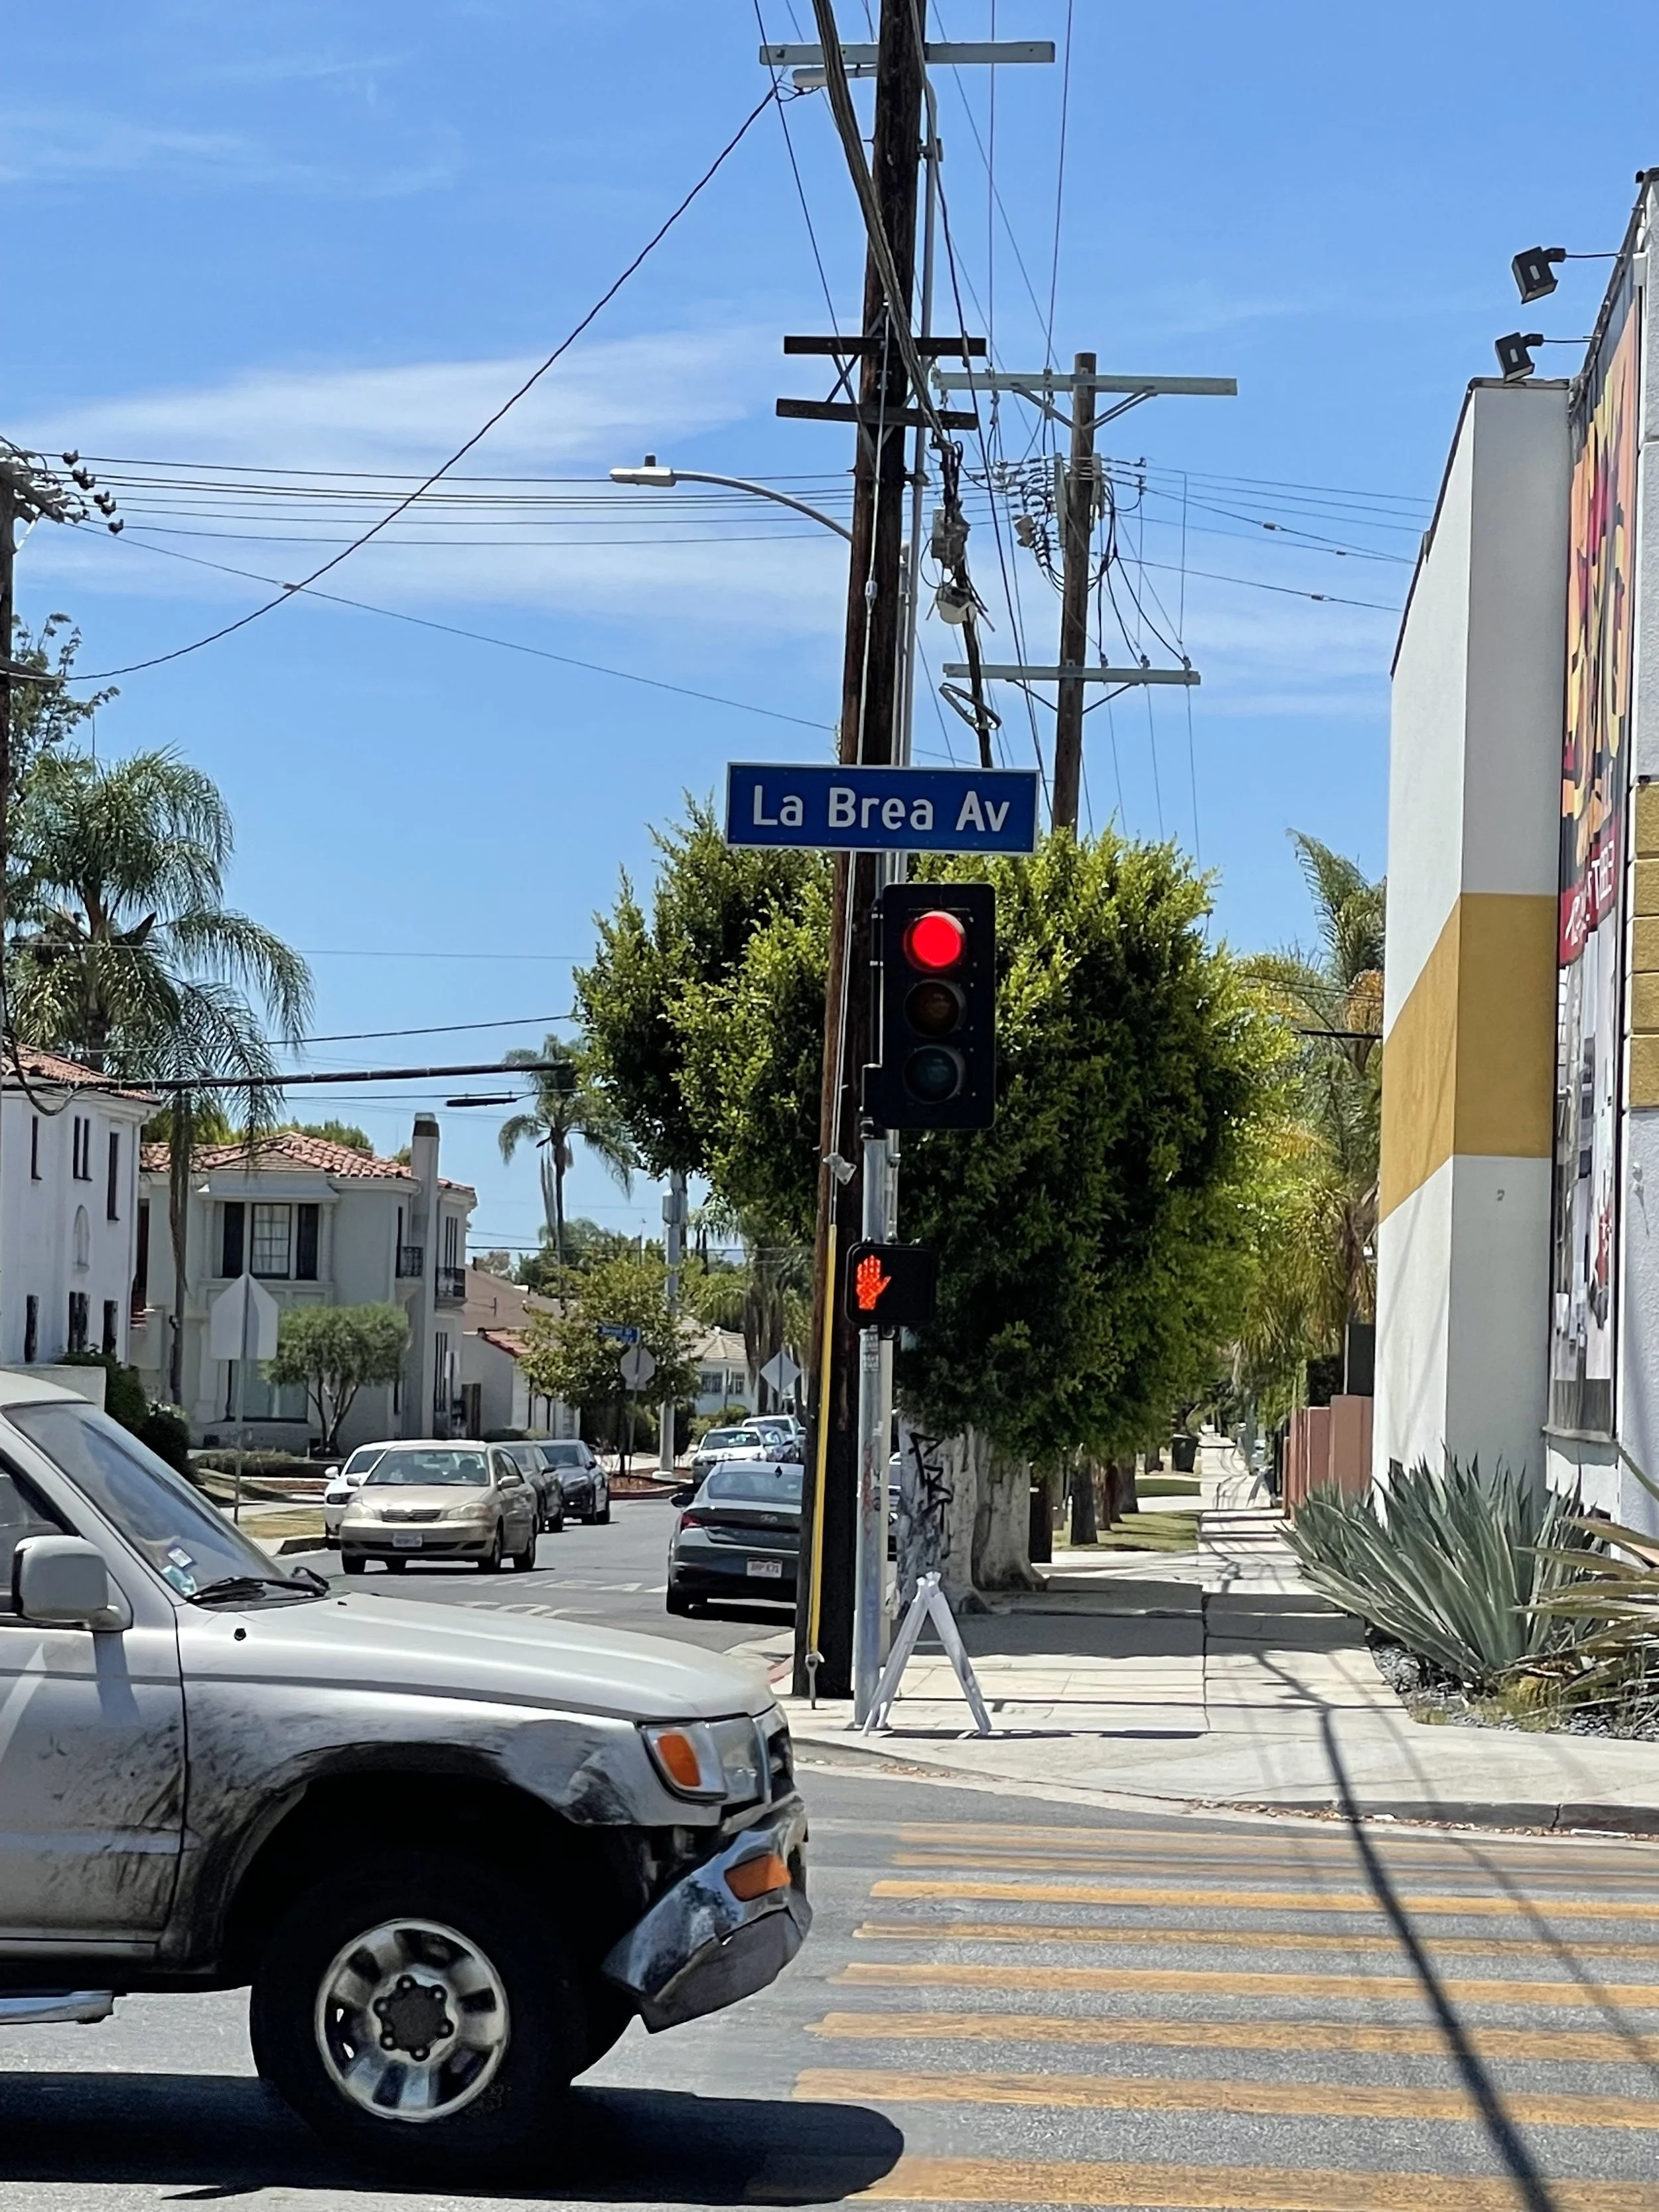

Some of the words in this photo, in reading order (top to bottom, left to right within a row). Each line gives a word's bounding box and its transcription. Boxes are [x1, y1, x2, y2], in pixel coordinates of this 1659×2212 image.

[753, 784, 804, 826] La
[828, 786, 934, 831] Brea
[956, 790, 1011, 832] Av
